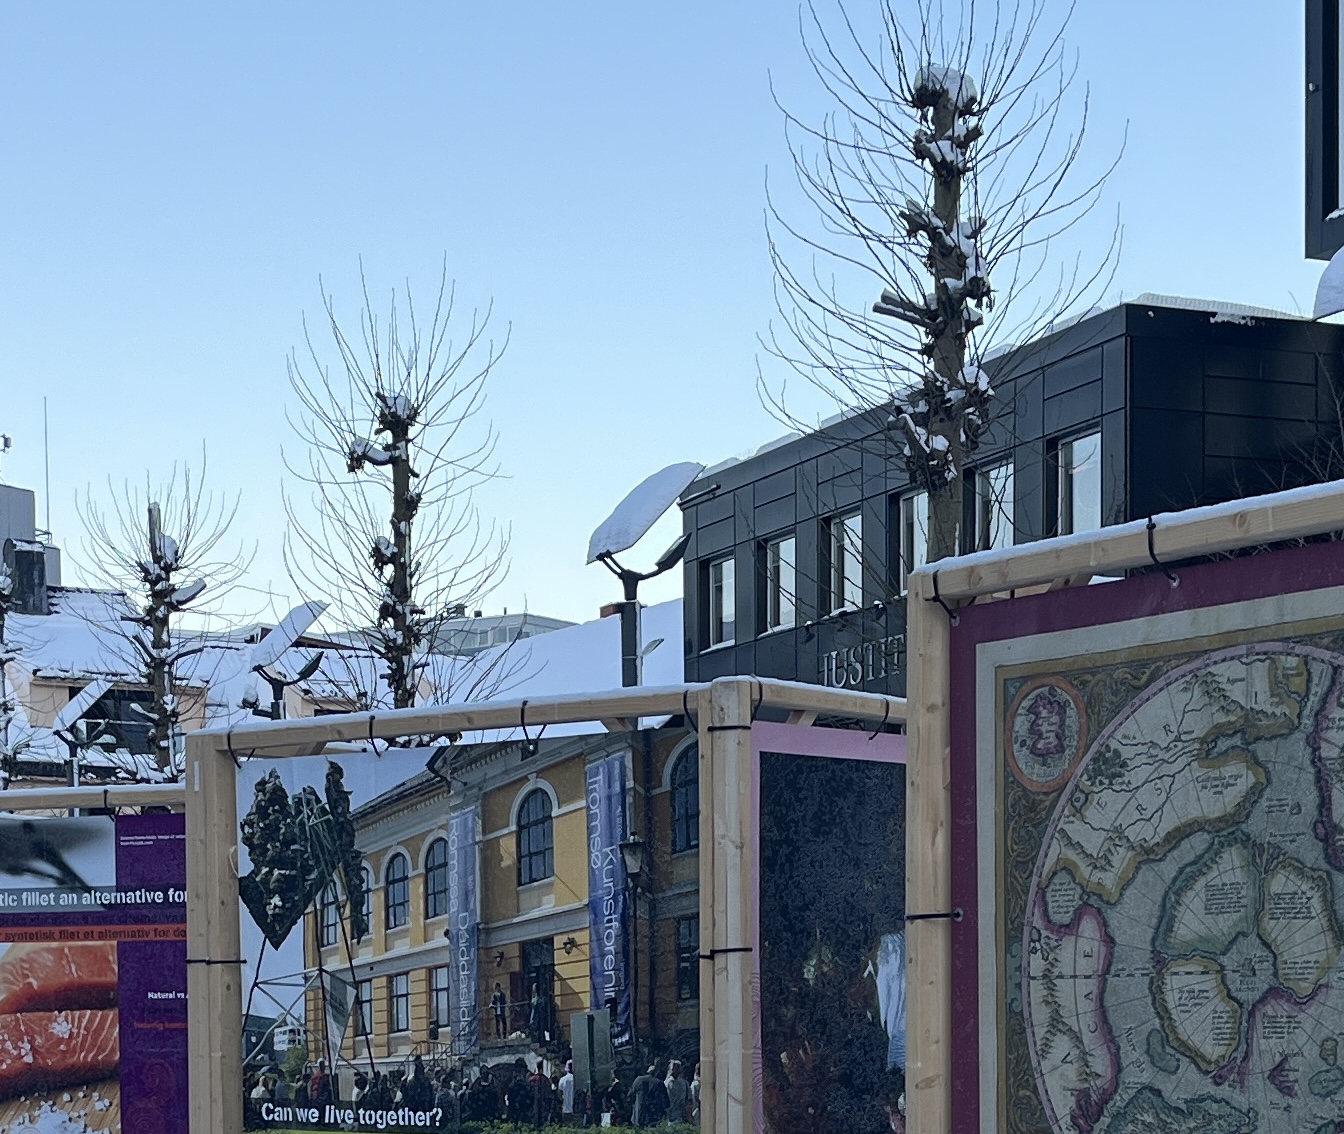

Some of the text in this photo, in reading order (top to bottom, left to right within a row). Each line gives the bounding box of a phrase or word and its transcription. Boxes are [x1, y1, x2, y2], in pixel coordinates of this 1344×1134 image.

[587, 766, 603, 868] Tromsø
[22, 891, 56, 906] fillet
[59, 893, 78, 905] an
[82, 888, 164, 905] alternative
[5, 929, 56, 942] syntetisk
[59, 928, 80, 940] filet
[84, 929, 96, 939] et
[98, 927, 151, 940] alternativ
[154, 927, 170, 938] for
[148, 991, 176, 999] Natural
[261, 1102, 443, 1130] Can we live together?
